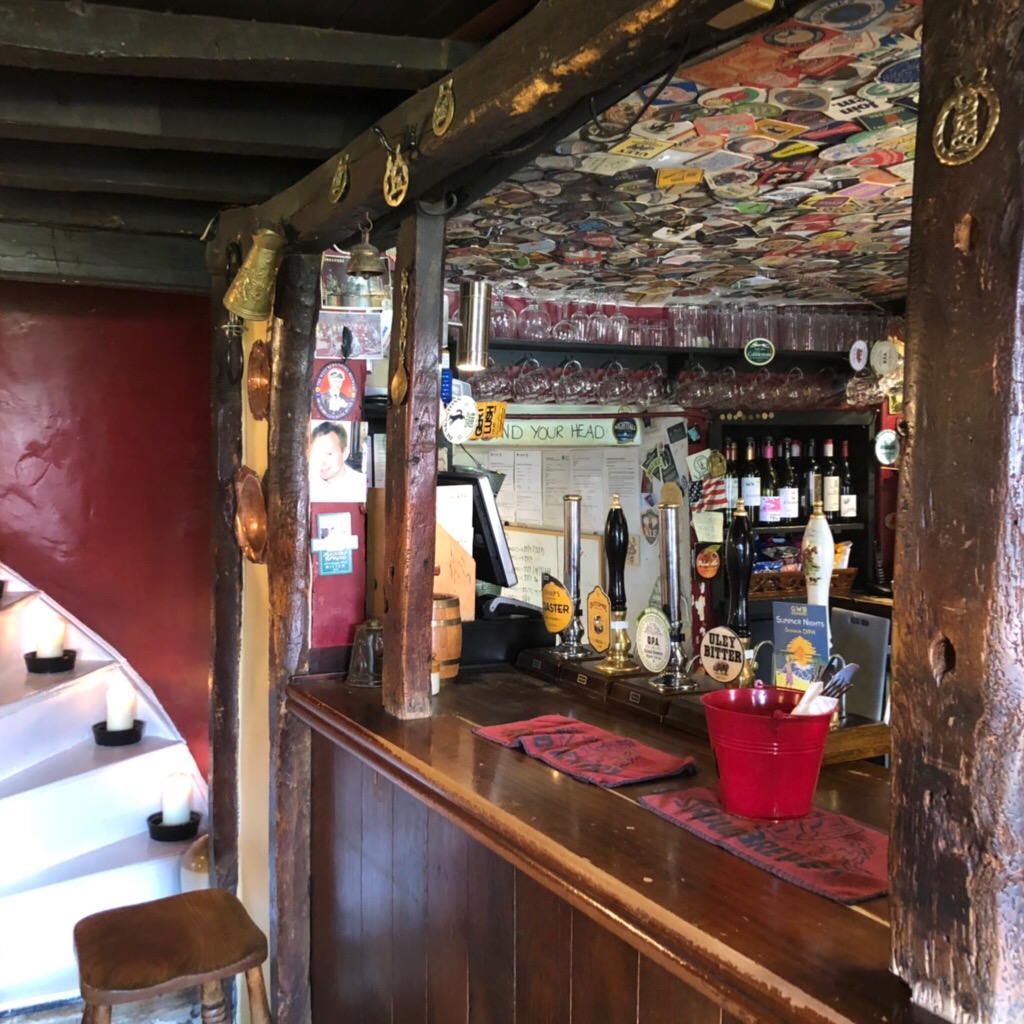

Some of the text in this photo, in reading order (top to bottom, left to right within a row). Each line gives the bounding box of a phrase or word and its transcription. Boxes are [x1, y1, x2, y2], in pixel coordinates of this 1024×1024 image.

[840, 101, 879, 115] Join
[484, 405, 494, 435] LUSH
[530, 424, 564, 440] YOUR
[571, 423, 605, 440] HEAD
[790, 605, 808, 613] GWB
[708, 632, 736, 648] ULEY
[703, 644, 742, 664] BITTER
